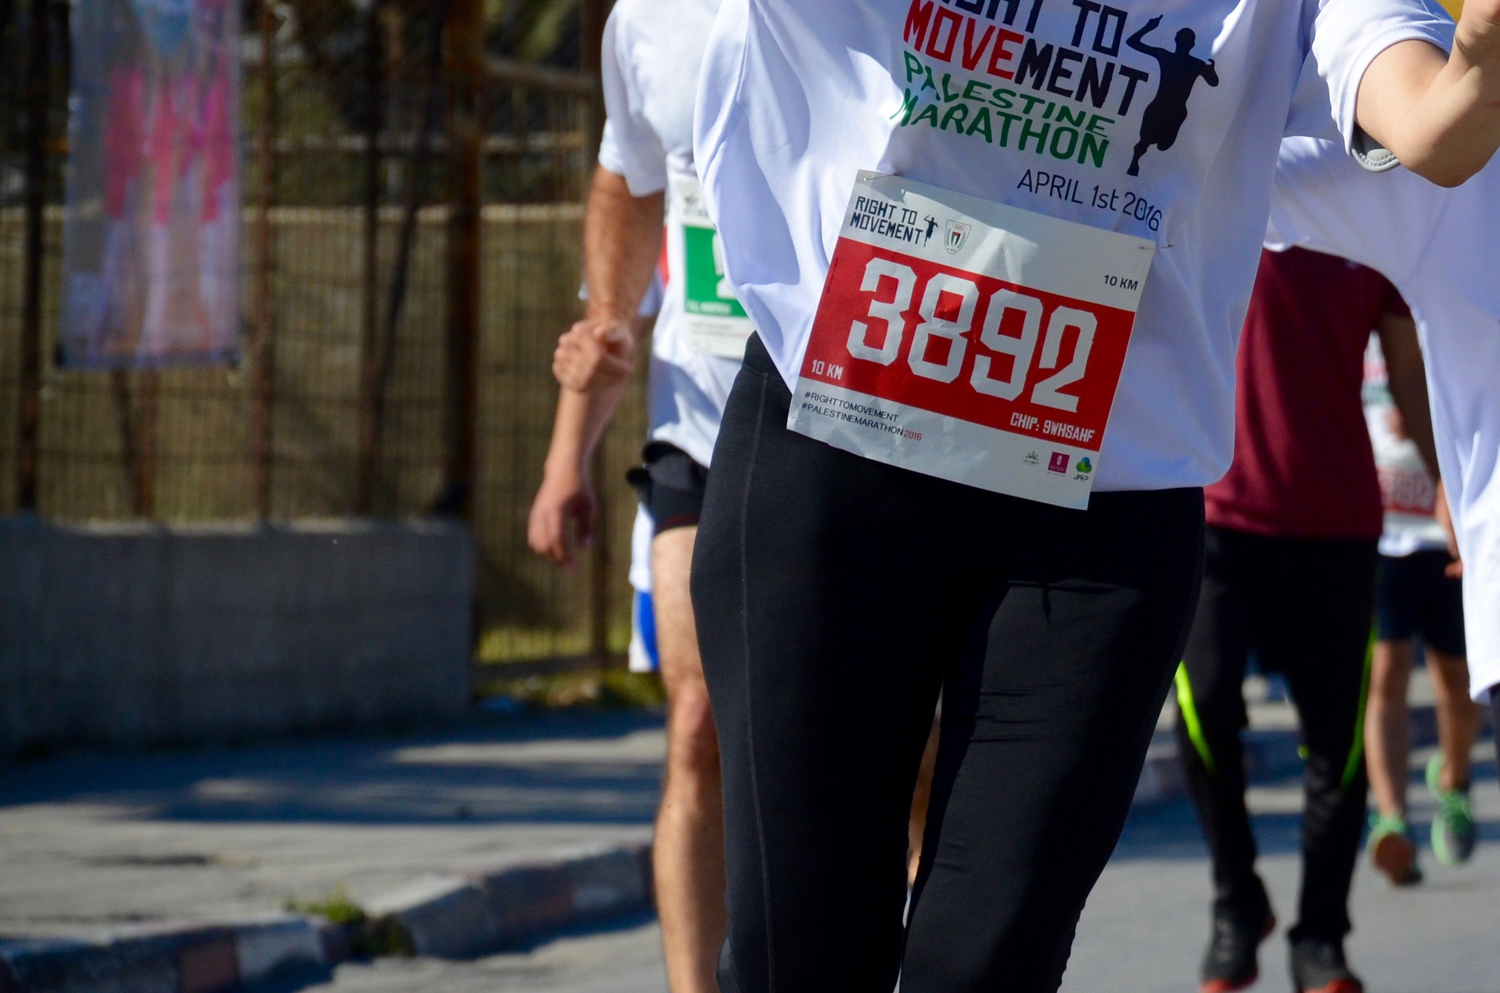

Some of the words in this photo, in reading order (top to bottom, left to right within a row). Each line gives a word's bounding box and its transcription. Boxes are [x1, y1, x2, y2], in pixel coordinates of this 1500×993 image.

[903, 49, 1116, 139] PALESTINE
[890, 88, 1110, 168] MARATHON
[854, 195, 898, 220] RIGHT
[901, 207, 918, 226] TO
[1016, 168, 1084, 205] APRIL
[1091, 184, 1120, 212] 1st
[1122, 191, 1163, 232] 2016
[849, 211, 924, 245] MOVEMENT
[1103, 274, 1118, 287] 10
[1119, 277, 1139, 292] KM
[845, 256, 1099, 414] 3892
[811, 359, 826, 375] 10
[827, 364, 844, 380] KM
[804, 391, 899, 423] #RIGHTTOMOVEMENT
[1010, 412, 1040, 432] CHIP:
[1042, 419, 1096, 443] 9WHSAHF
